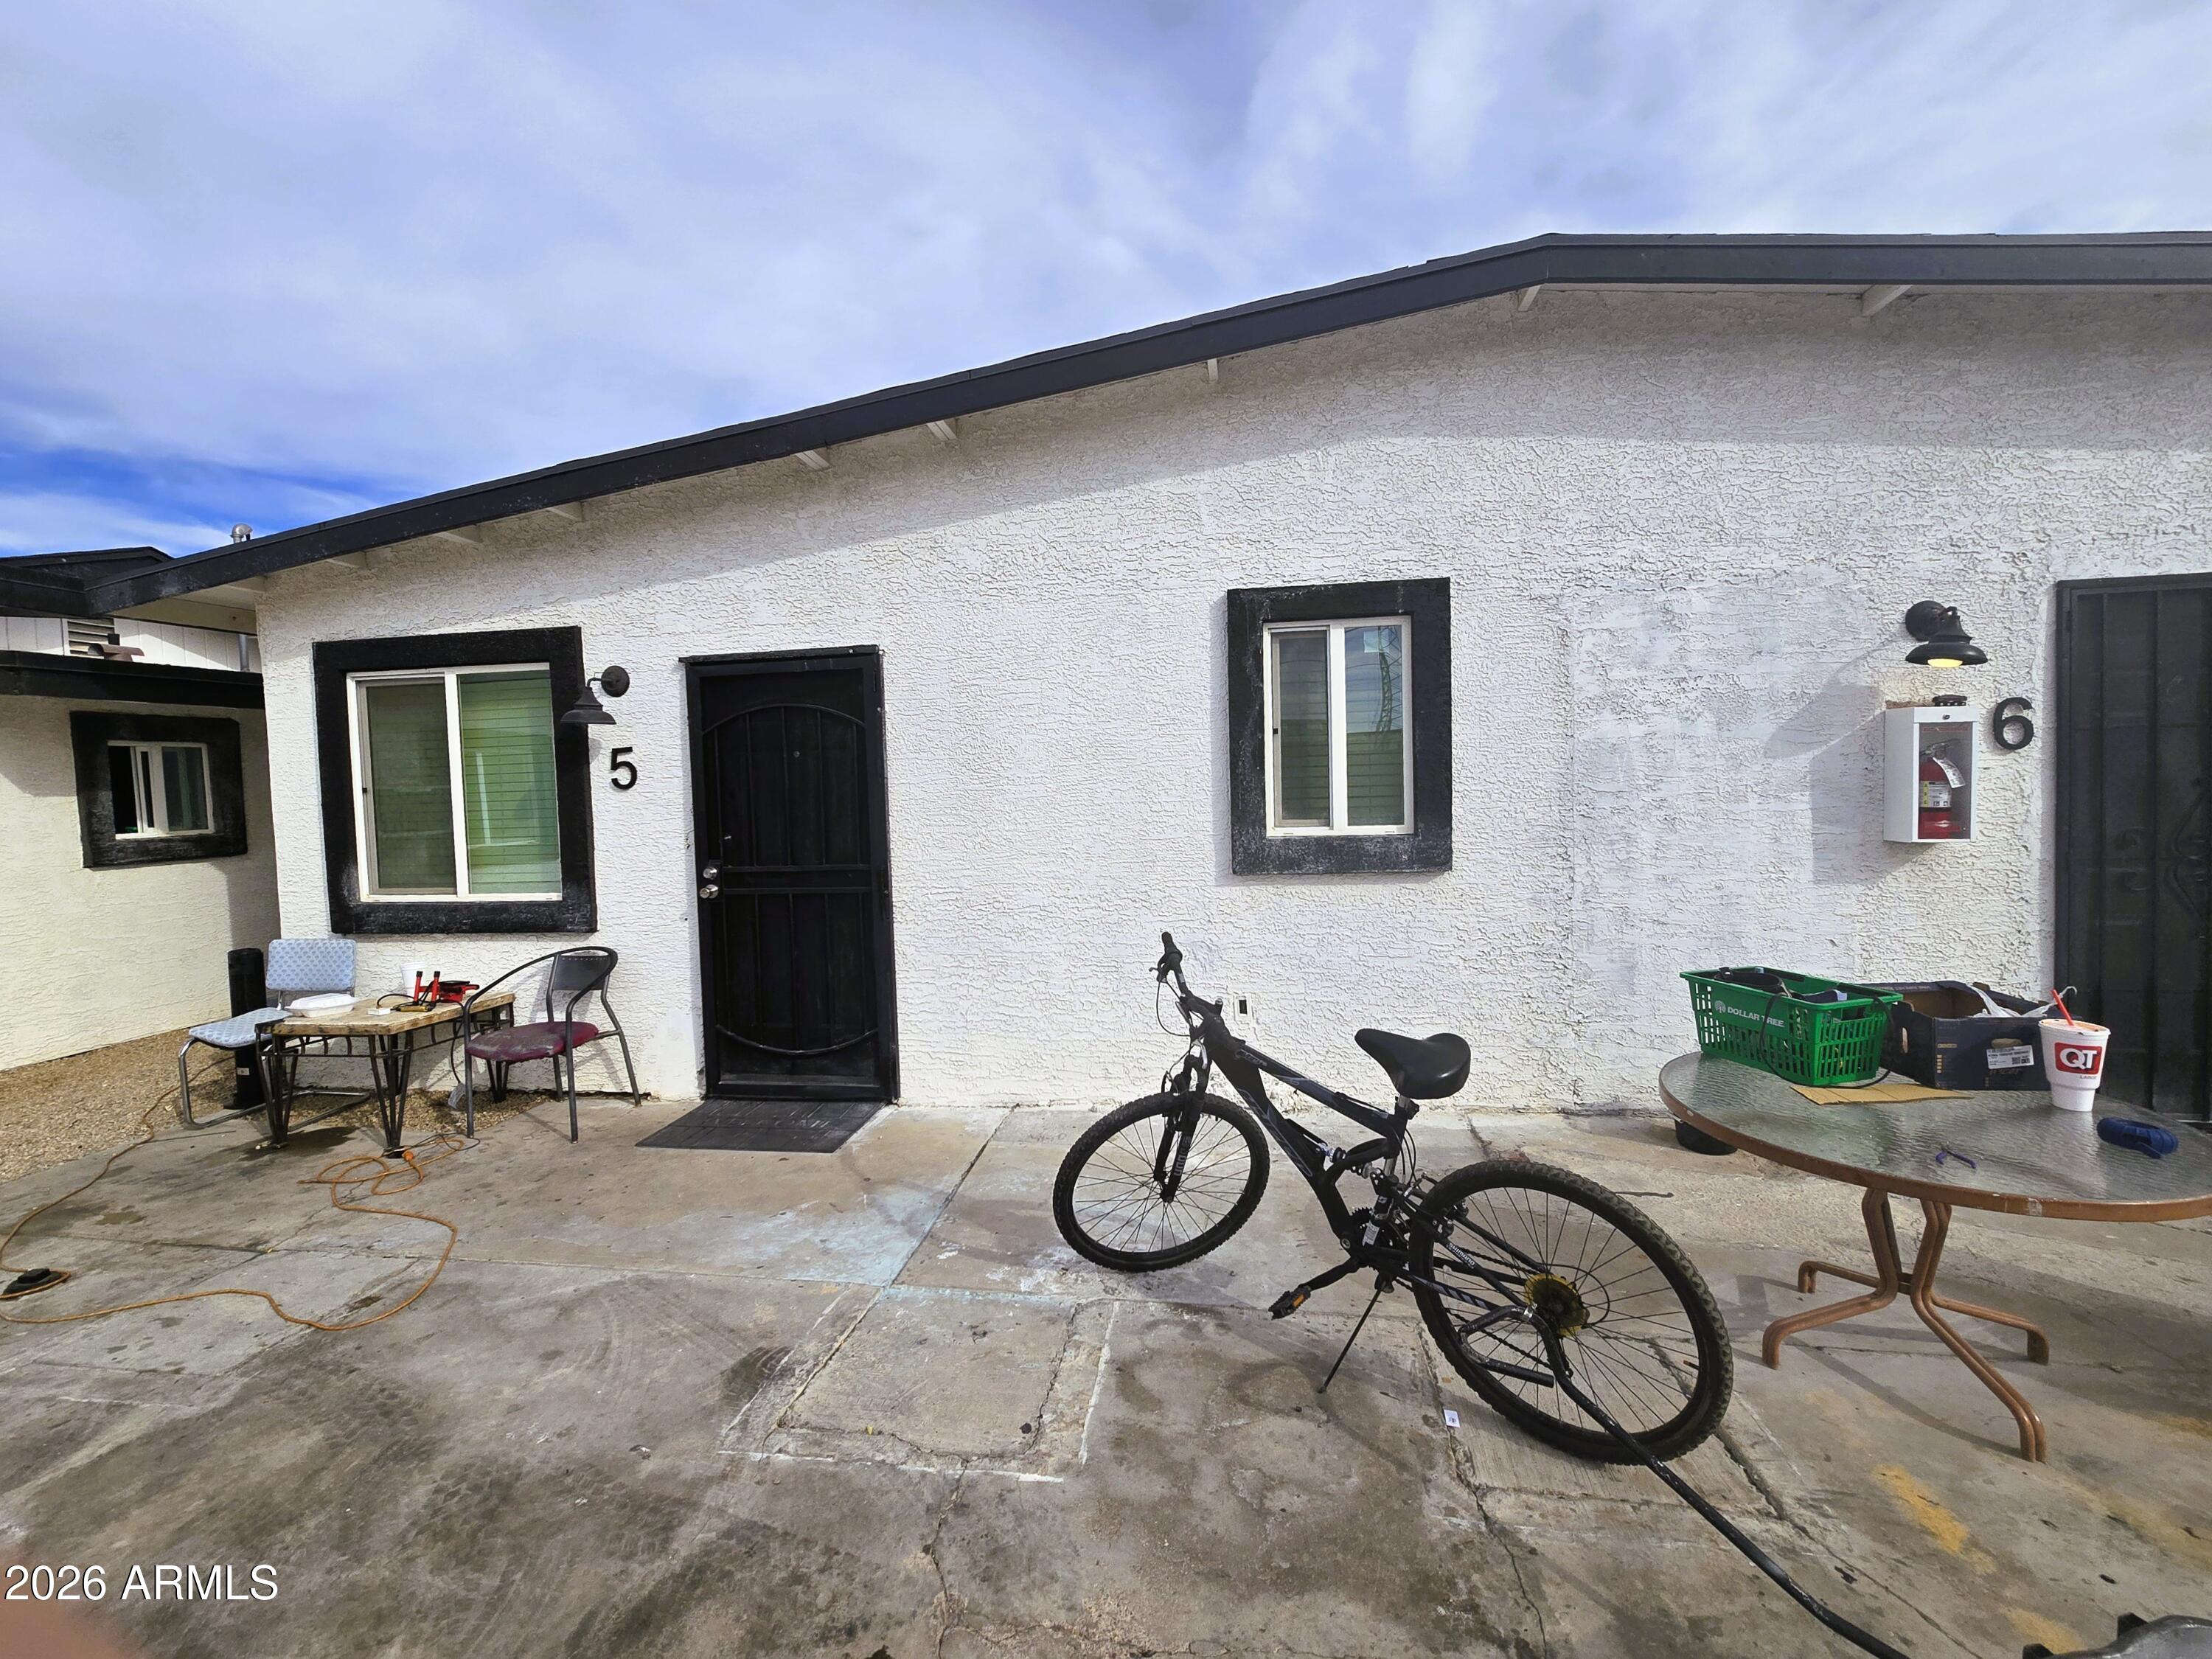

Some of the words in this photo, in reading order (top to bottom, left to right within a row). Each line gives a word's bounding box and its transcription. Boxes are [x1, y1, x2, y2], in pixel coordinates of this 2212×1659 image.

[1993, 697, 2034, 750] 6
[611, 747, 637, 790] 5
[1728, 1006, 1759, 1020] DOLLAR
[2059, 1048, 2098, 1070] QT
